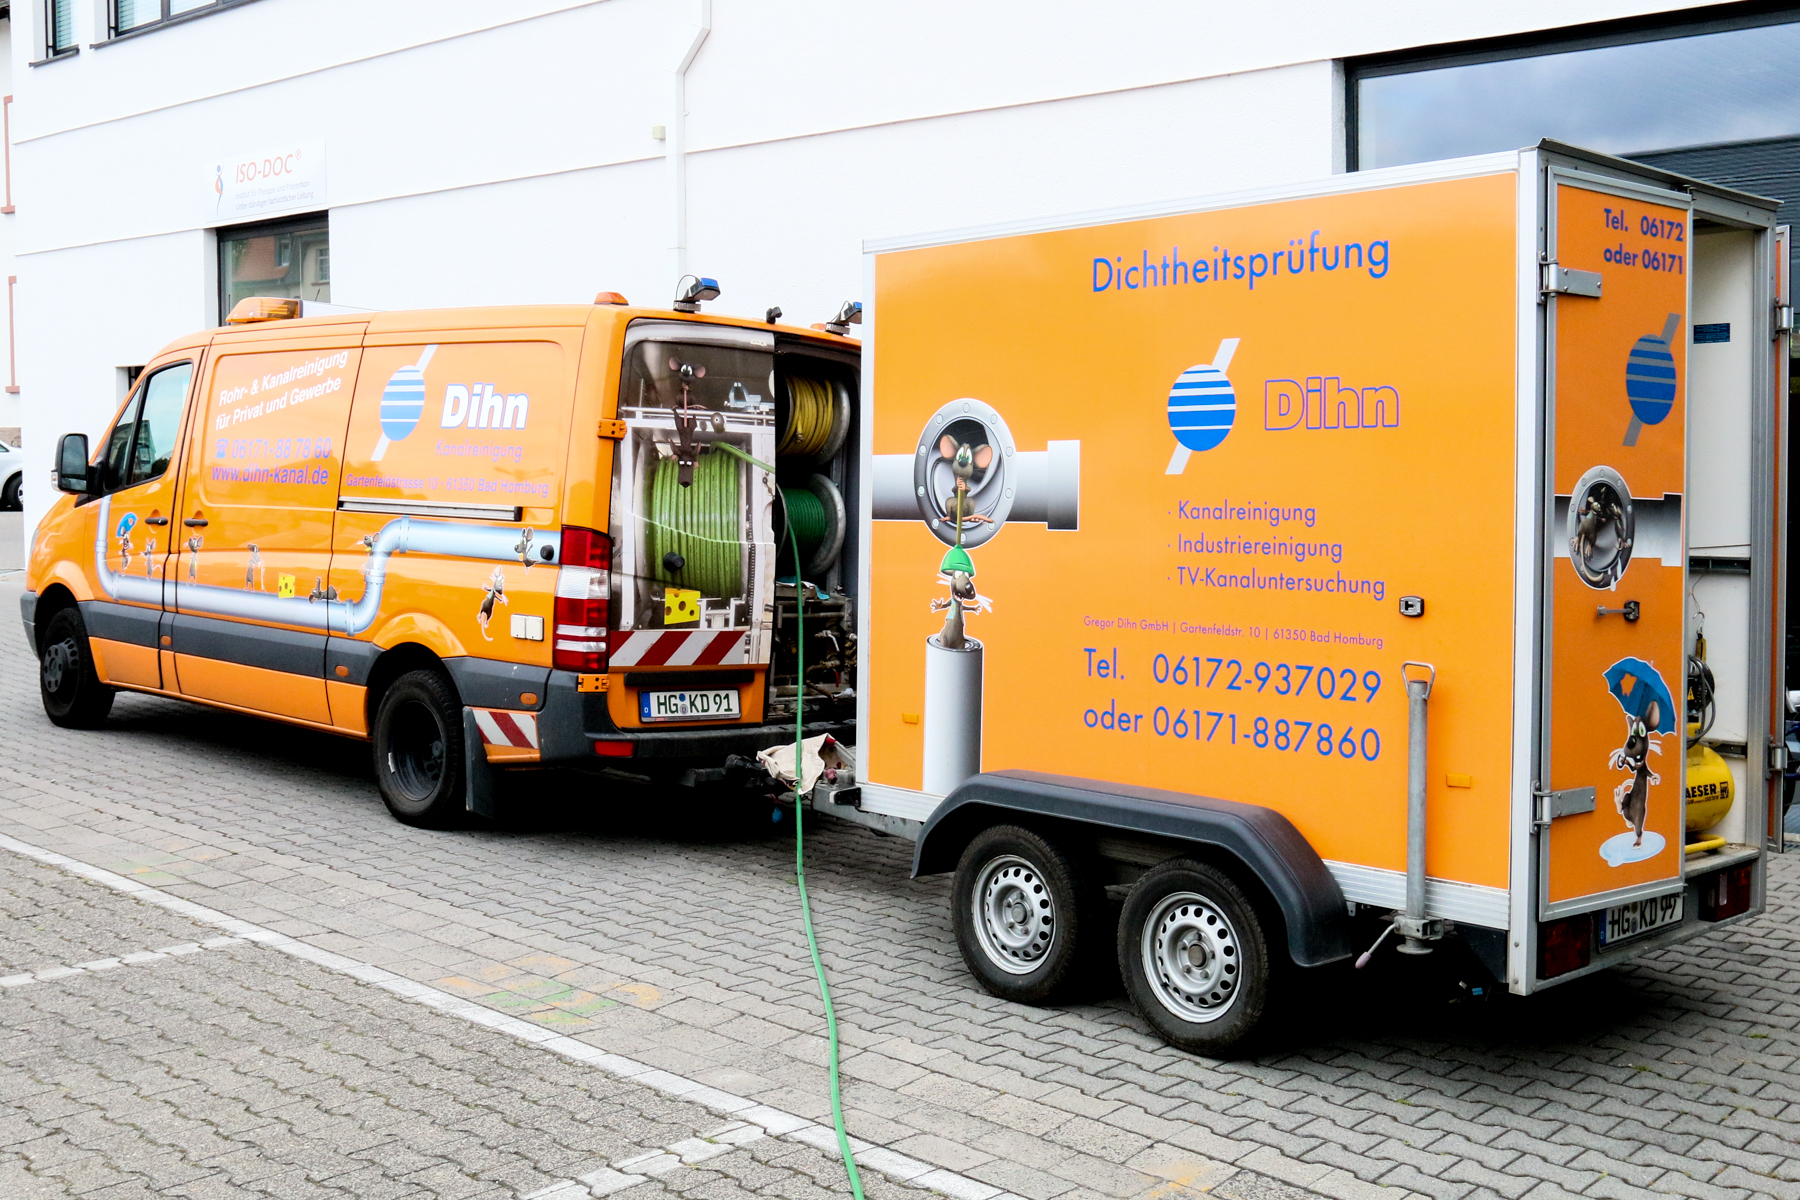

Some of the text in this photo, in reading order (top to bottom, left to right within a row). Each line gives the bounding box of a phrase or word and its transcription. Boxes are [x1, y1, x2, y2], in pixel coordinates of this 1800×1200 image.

[297, 191, 314, 200] Leitung
[1604, 208, 1684, 242] Tel. 06172
[1093, 229, 1390, 292] Dichtheitsprüfung
[1603, 243, 1683, 275] oder 06171
[219, 351, 349, 406] Rohr- & Kanalreinigung
[215, 377, 342, 430] für Privat und Gewerbe
[440, 382, 529, 429] Dihn
[1264, 376, 1399, 431] Dihn
[295, 438, 311, 459] 78
[314, 438, 332, 459] 60
[435, 438, 523, 463] Kanalreinigung
[212, 463, 329, 485] www.dihn-kanal.de
[346, 473, 549, 498] Gartenfeldstrasse 10 61350 Bad Homburg
[1178, 499, 1316, 528] Kanalreinigung
[1178, 532, 1343, 563] Industriereinigung
[1177, 566, 1386, 601] TV-Kanaluntersuchung
[1083, 615, 1384, 650] Gregor Dihn GmbH Gartenfeldstr. 10 61350 Bad Homburg
[1084, 648, 1382, 704] Tel. 06172-937029
[657, 693, 733, 714] HG KD 91
[1084, 699, 1381, 762] oder 06171-887860
[1609, 906, 1630, 939] HG
